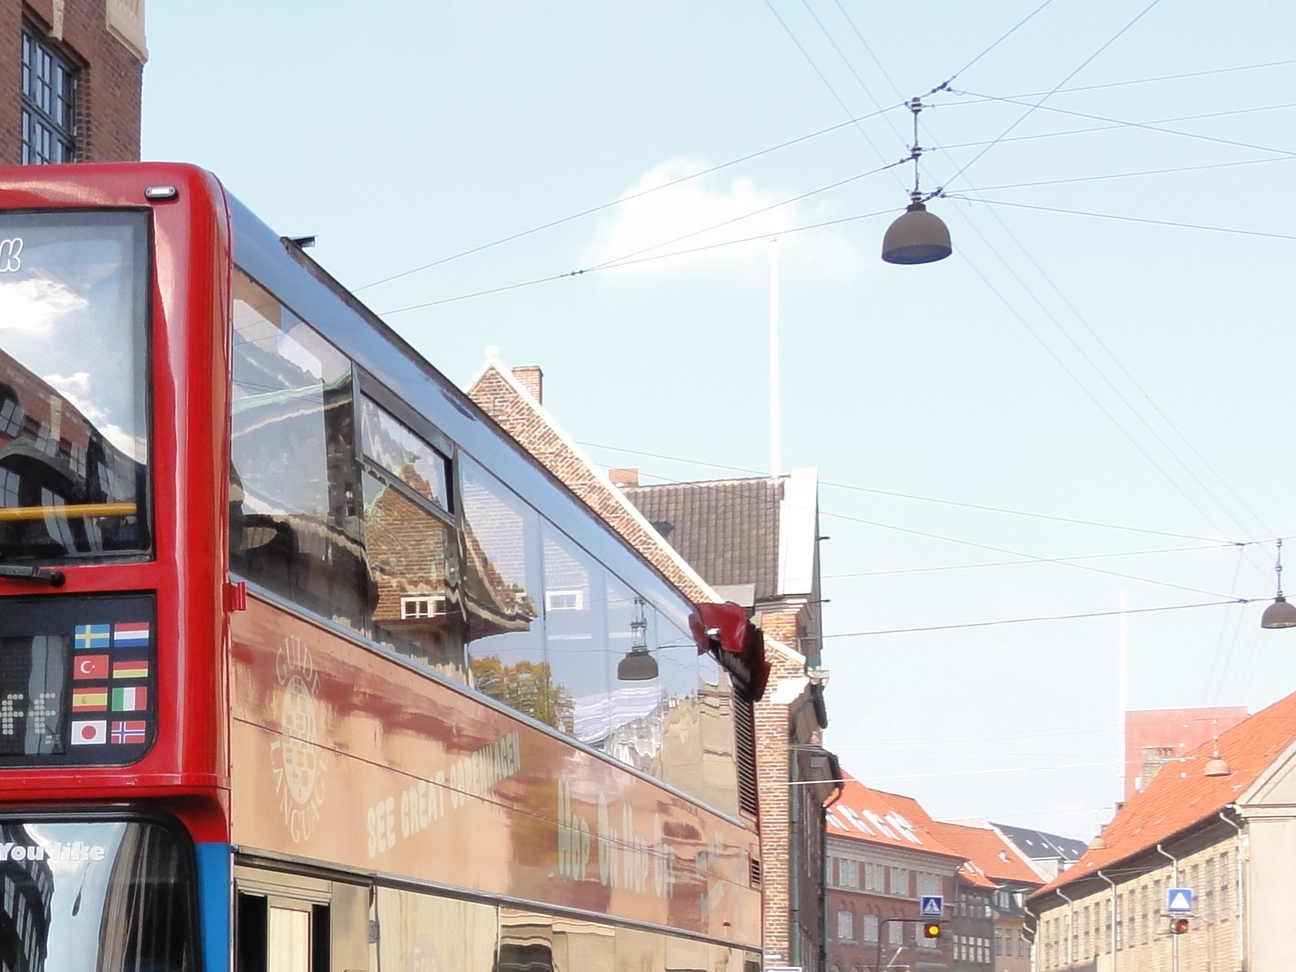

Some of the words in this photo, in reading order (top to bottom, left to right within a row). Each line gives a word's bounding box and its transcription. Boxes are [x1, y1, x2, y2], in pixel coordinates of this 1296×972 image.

[367, 796, 396, 859] SEE
[400, 770, 445, 839] GREAT
[53, 840, 106, 861] like
